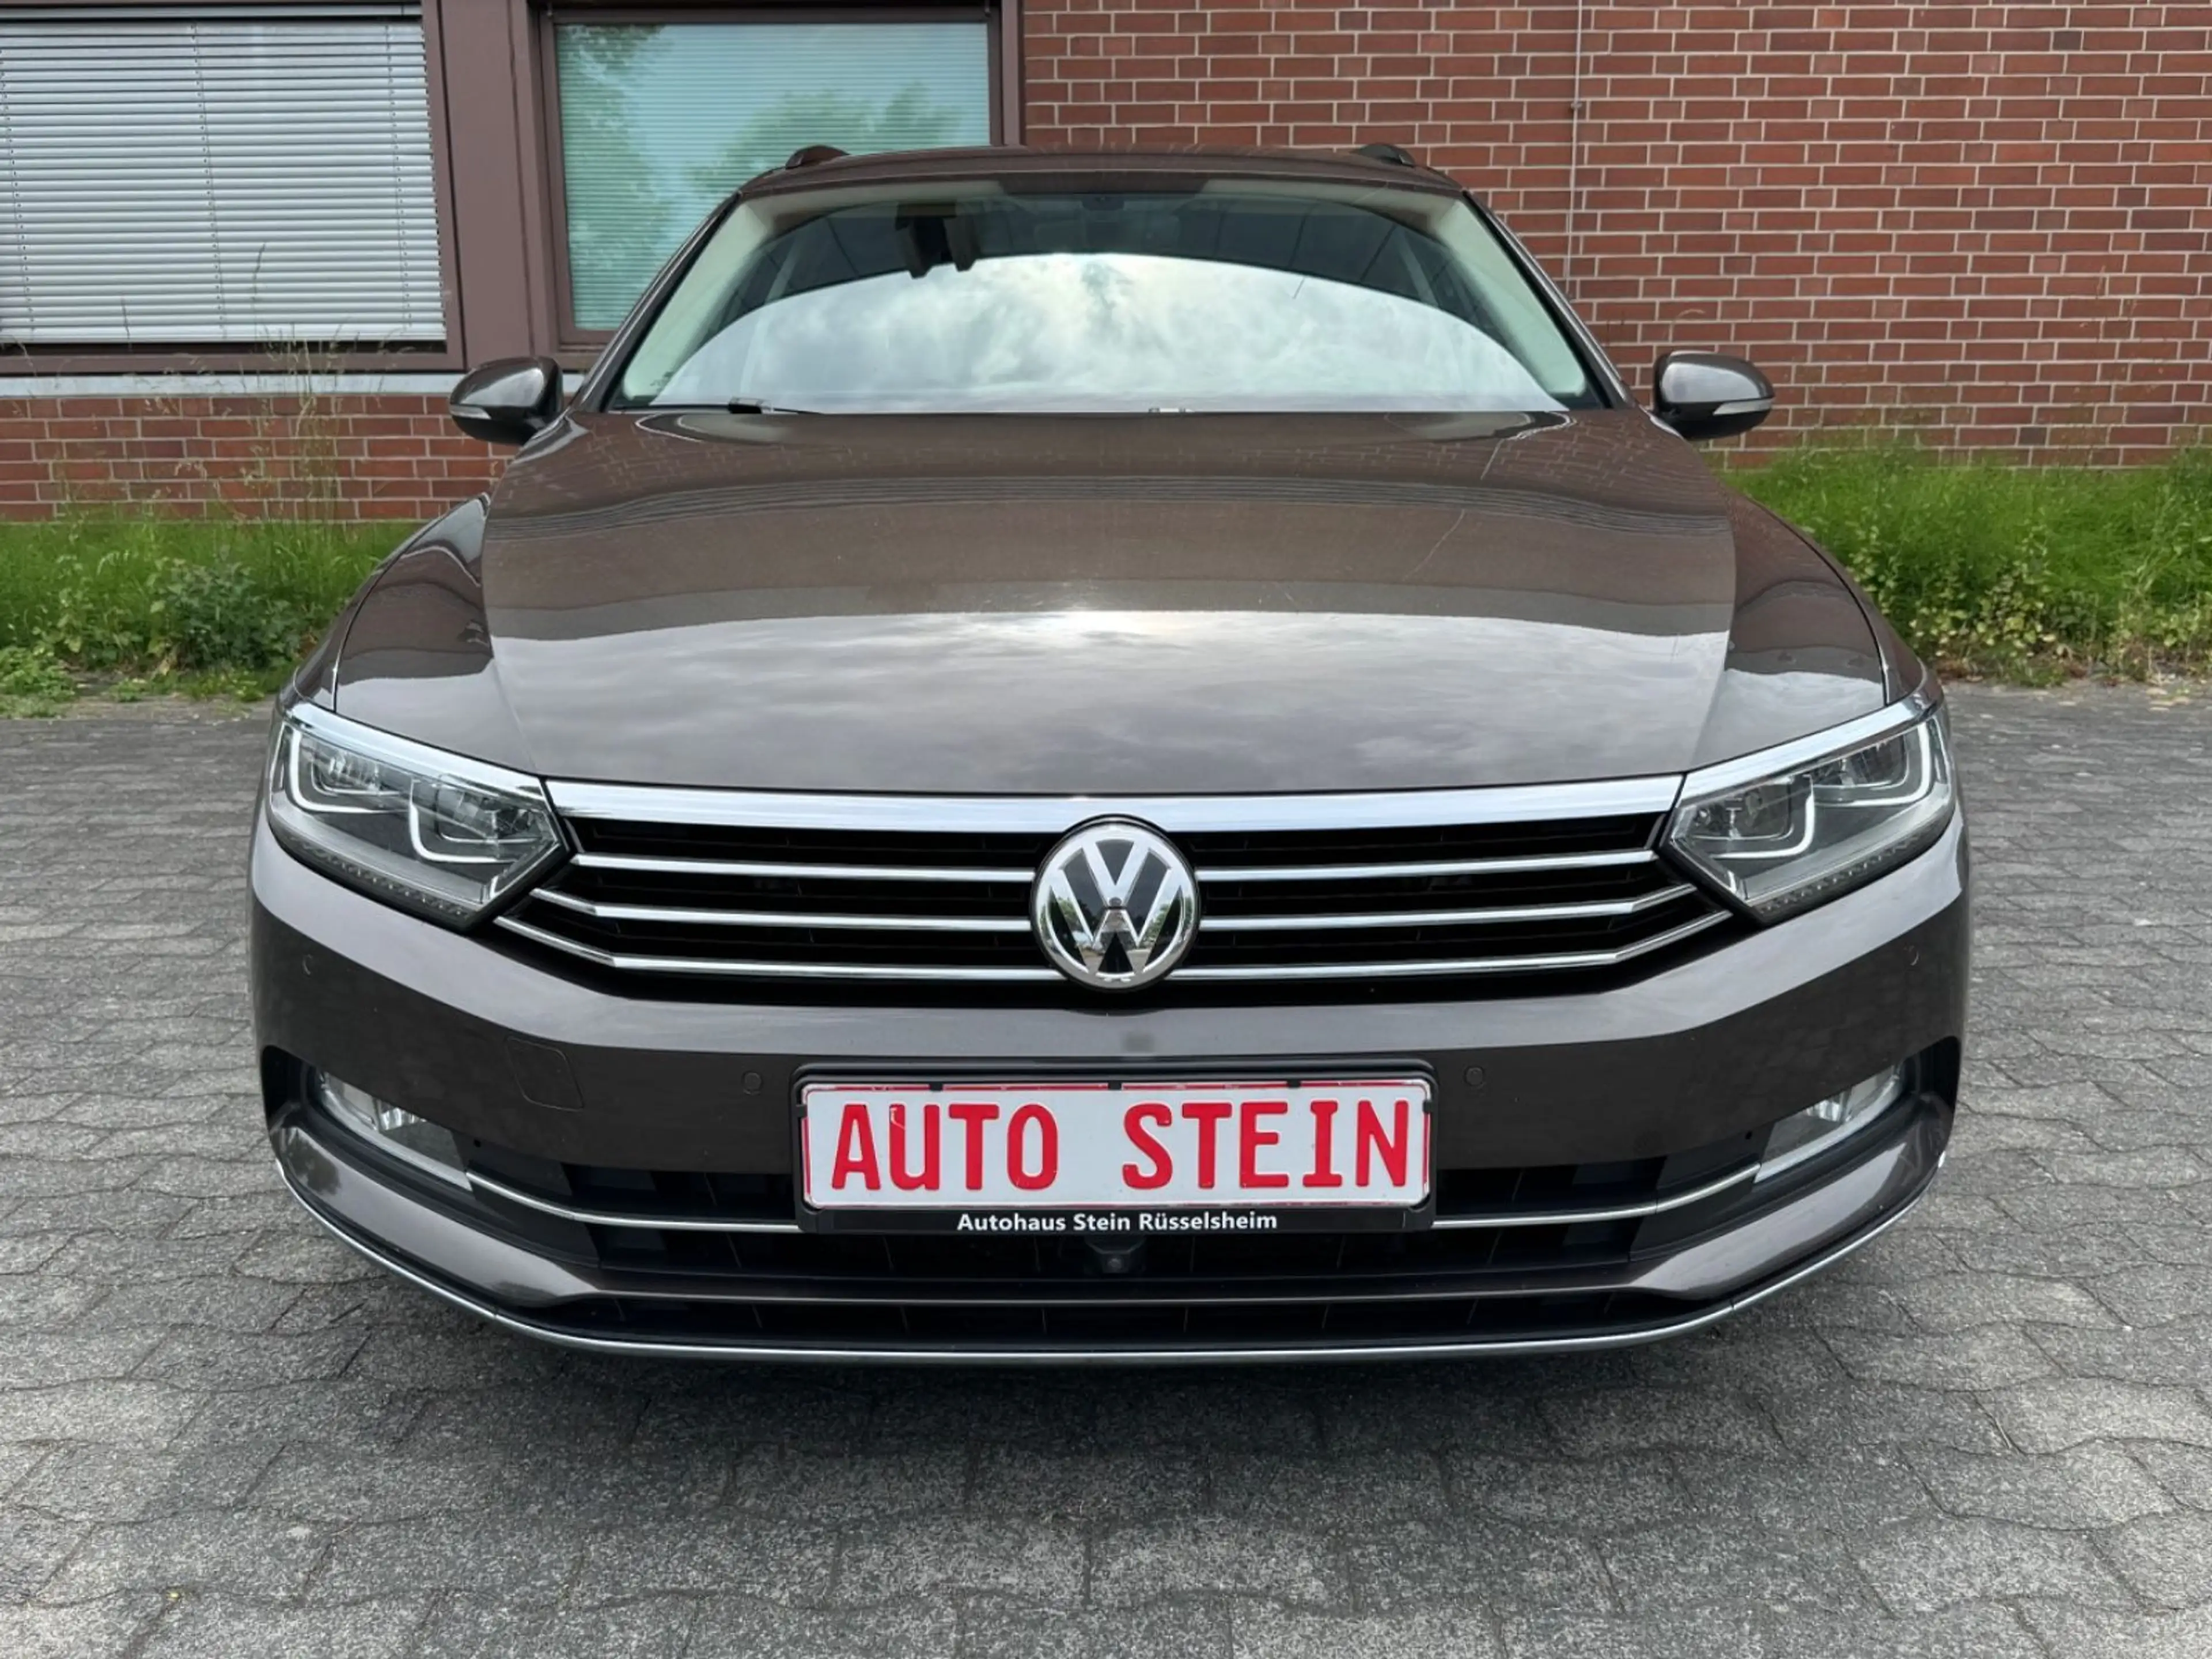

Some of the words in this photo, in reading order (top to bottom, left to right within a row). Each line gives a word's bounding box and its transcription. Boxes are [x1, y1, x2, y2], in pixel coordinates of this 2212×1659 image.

[1035, 823, 1196, 988] VW
[831, 1103, 1059, 1191] AUTO
[1122, 1099, 1410, 1190] STEIN
[956, 1213, 1067, 1231] Autohaus
[1073, 1213, 1131, 1231] Stein
[1138, 1211, 1278, 1230] Rüsselsheim
